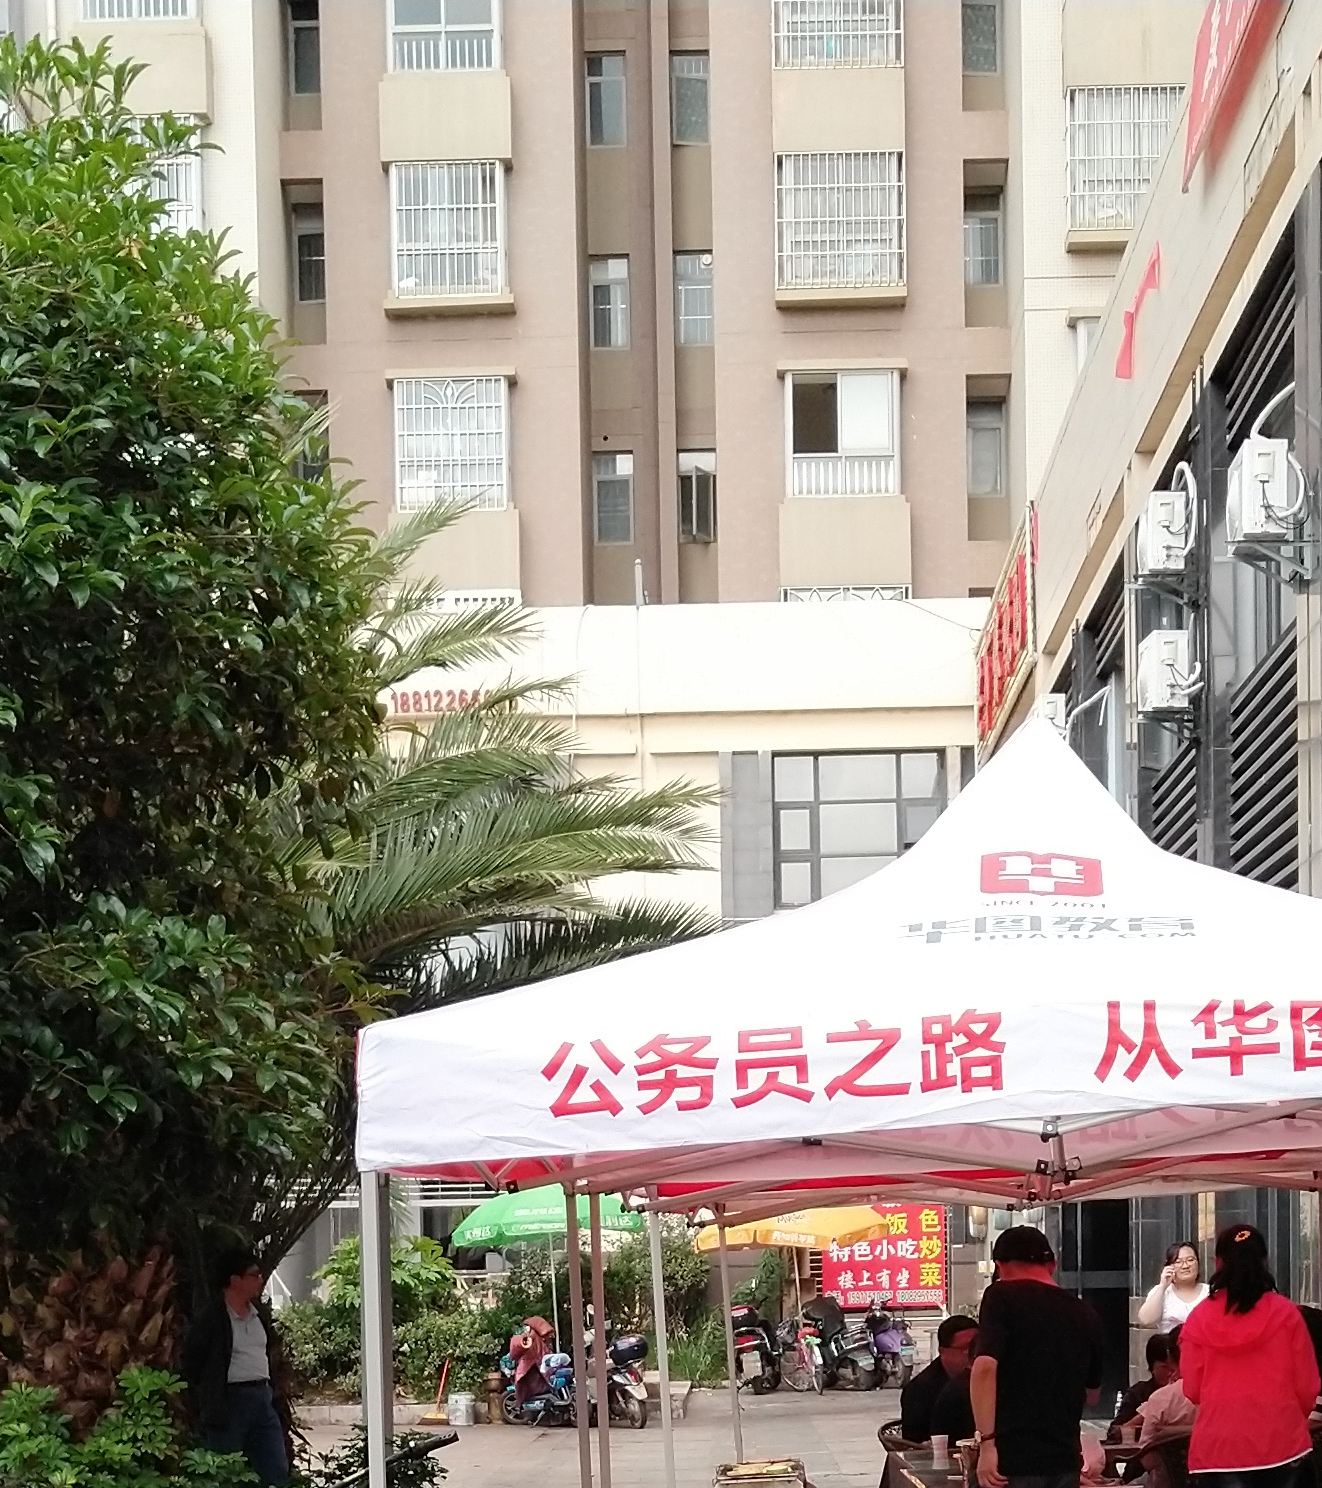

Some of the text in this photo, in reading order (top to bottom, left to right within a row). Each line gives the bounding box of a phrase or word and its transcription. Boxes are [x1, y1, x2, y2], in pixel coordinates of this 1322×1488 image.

[541, 1009, 1006, 1118] 公务员之路
[829, 1238, 919, 1262] 特色小吃
